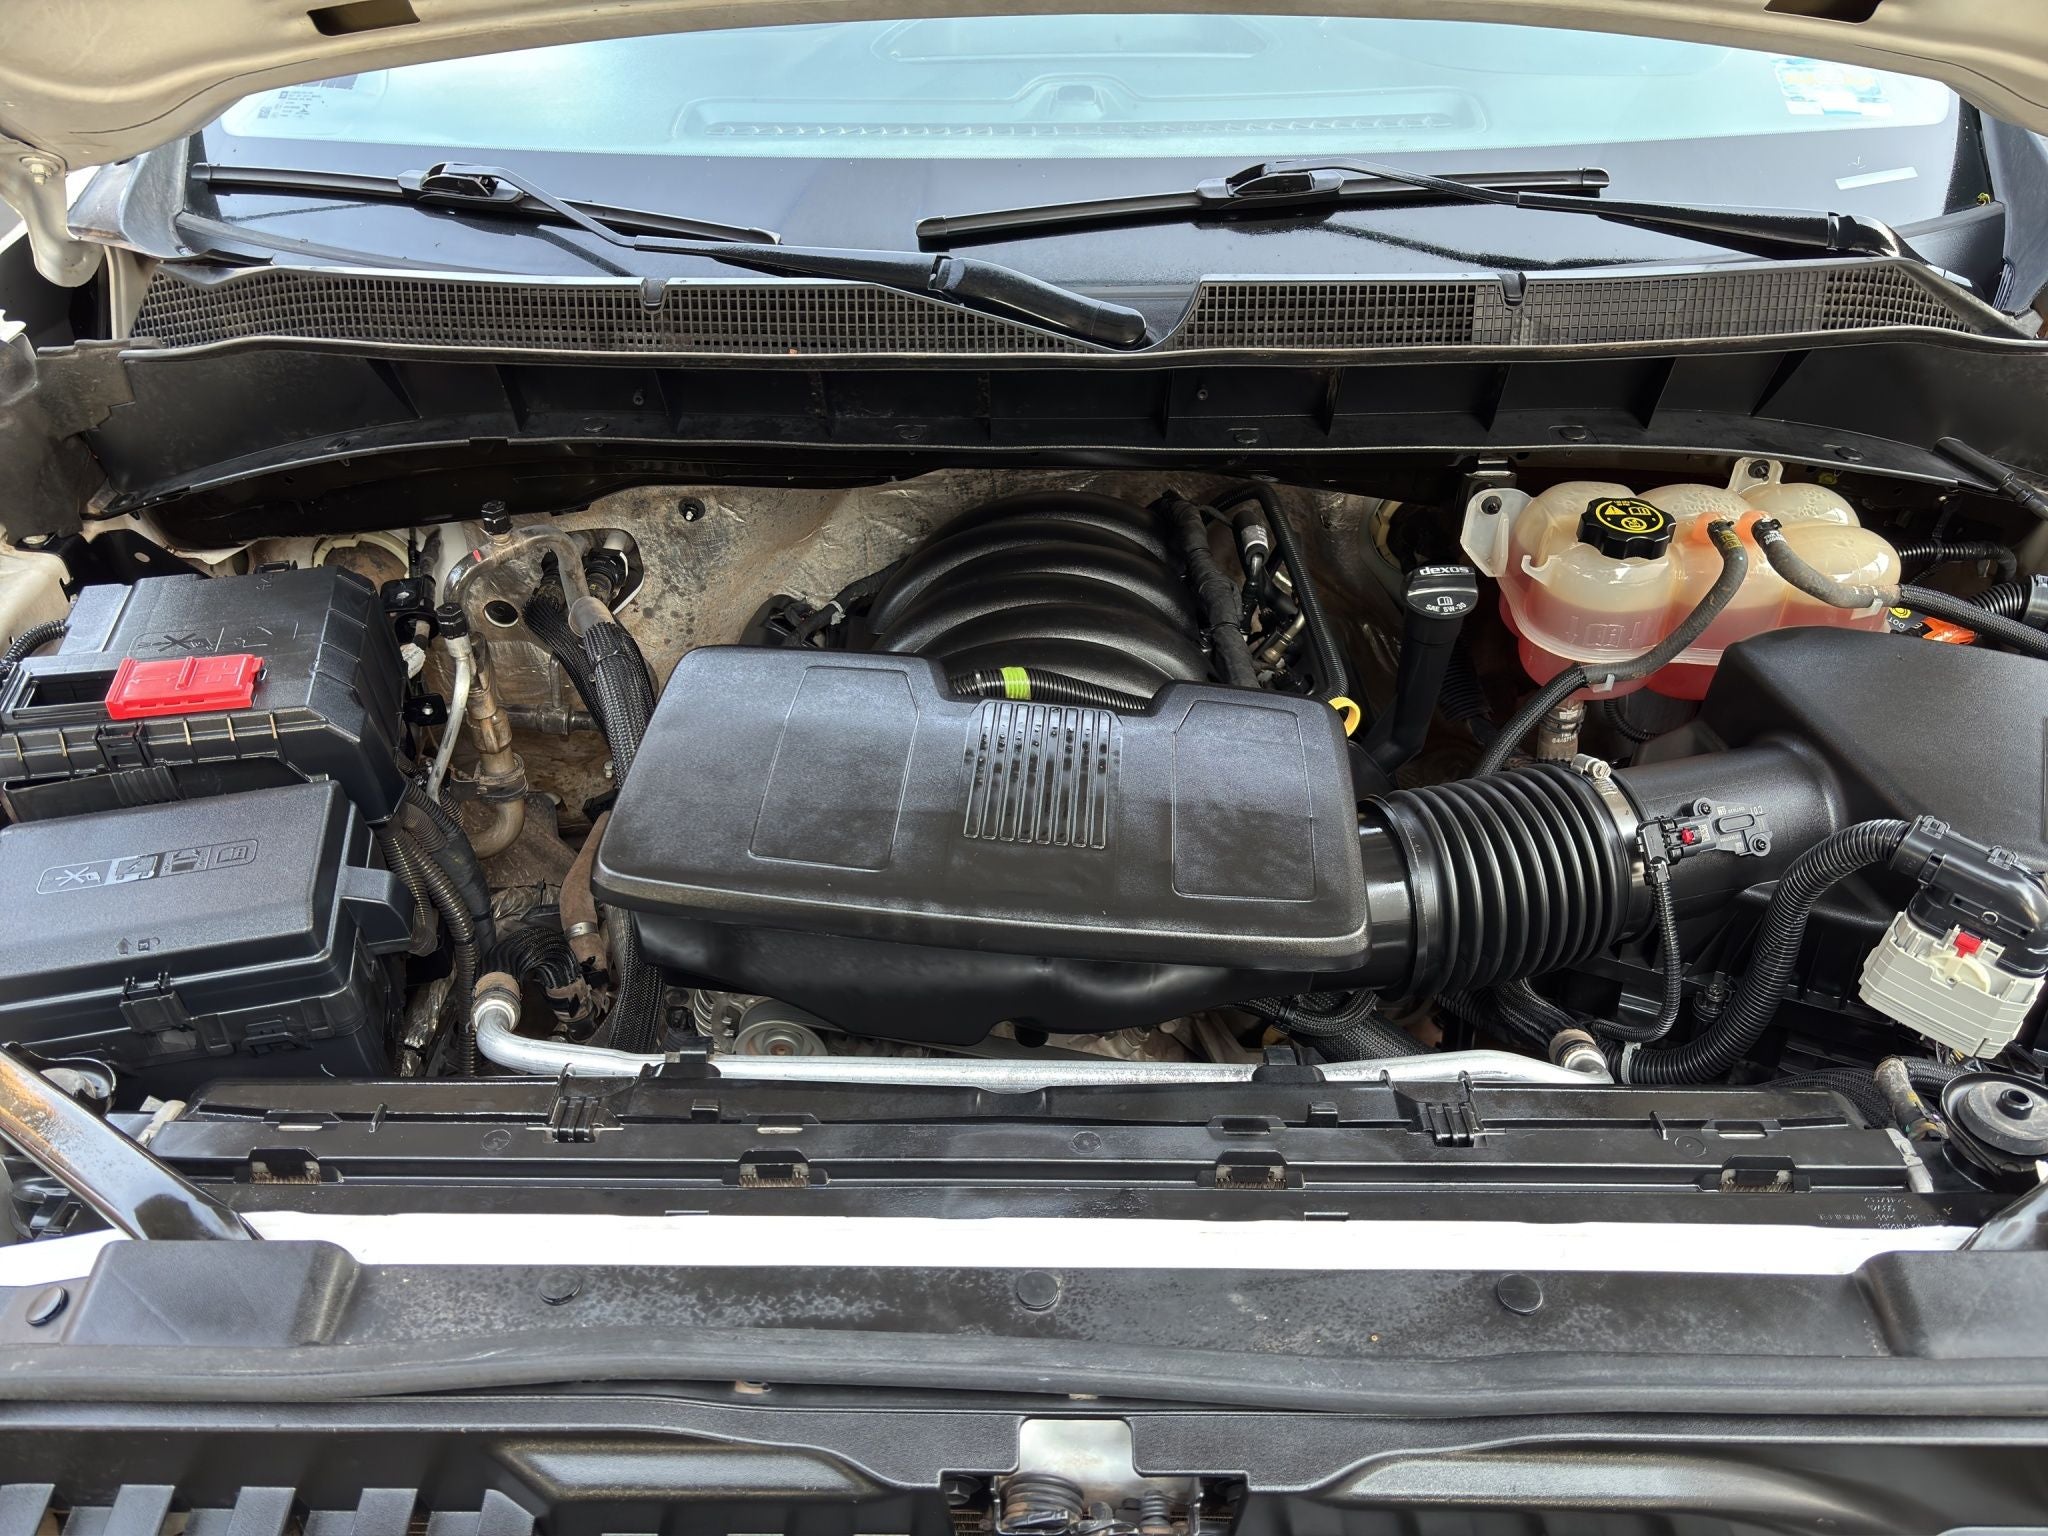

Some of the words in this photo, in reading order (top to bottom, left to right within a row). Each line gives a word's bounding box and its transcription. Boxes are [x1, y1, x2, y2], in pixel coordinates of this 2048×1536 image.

[1420, 567, 1469, 575] dexos
[1426, 604, 1440, 612] SAE
[1443, 602, 1466, 612] 5W-30
[1888, 617, 1905, 628] DOT
